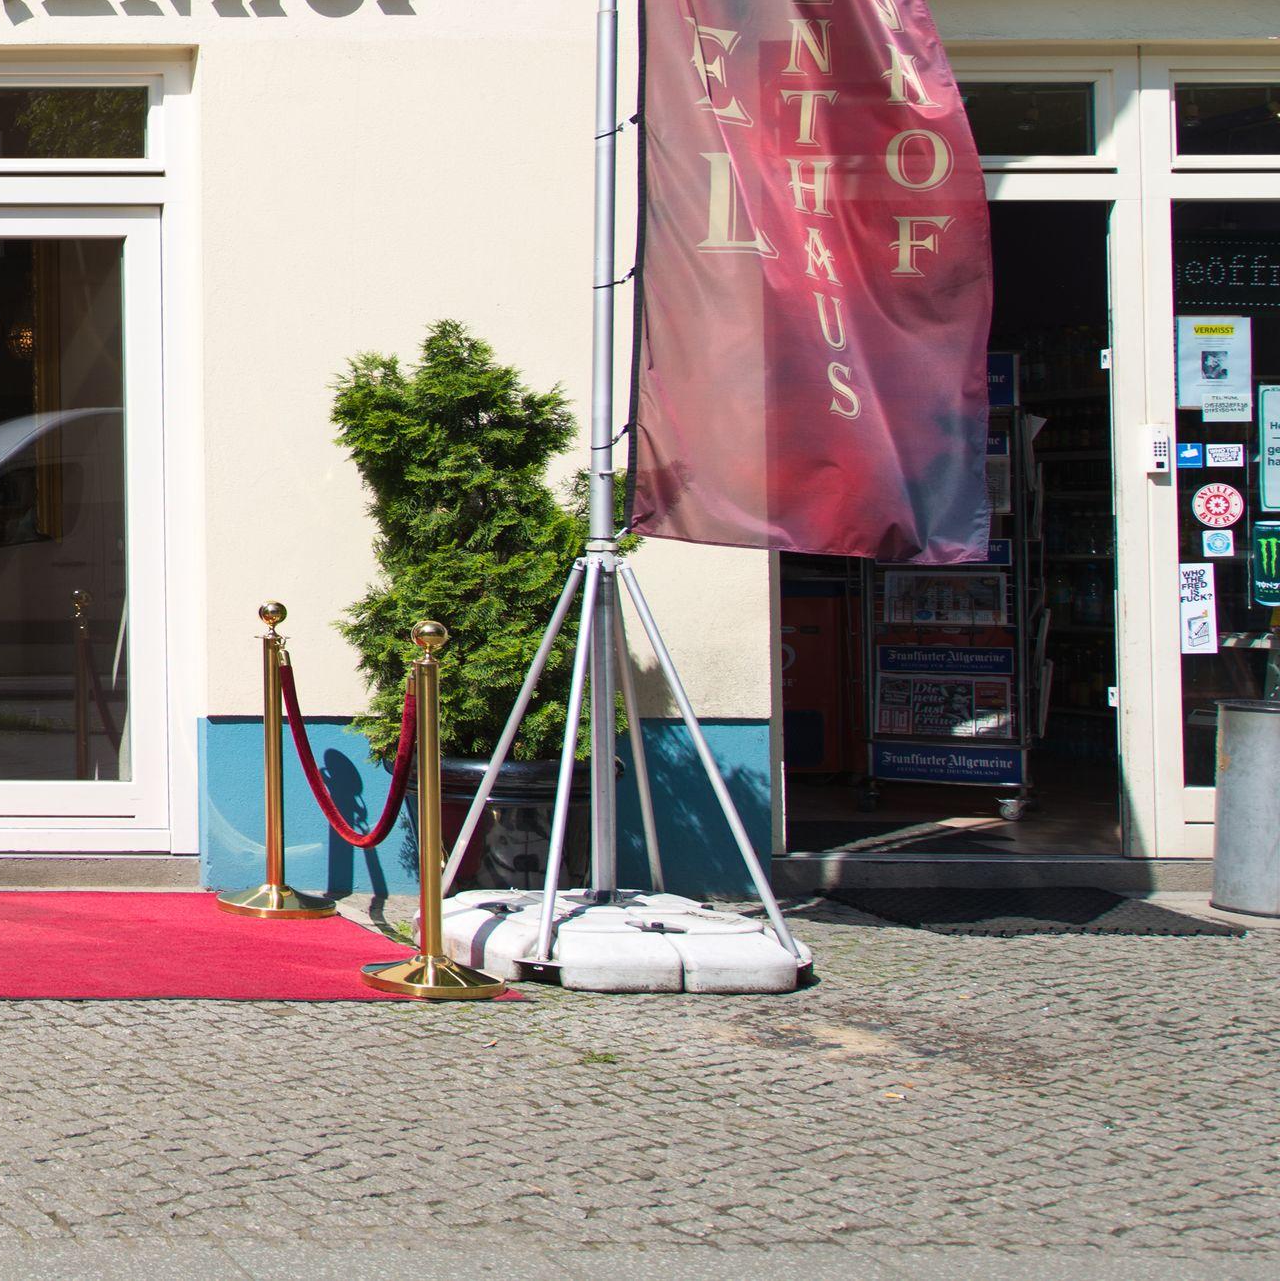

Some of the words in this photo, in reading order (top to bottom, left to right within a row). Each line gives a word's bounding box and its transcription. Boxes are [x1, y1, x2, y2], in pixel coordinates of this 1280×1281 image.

[1197, 486, 1235, 500] WULLE
[1198, 511, 1236, 525] BIERE
[1182, 569, 1205, 577] WHO
[1181, 581, 1207, 590] FRED
[1190, 587, 1199, 595] IS
[1180, 593, 1213, 603] FUCK?
[887, 650, 945, 662] Frankfurter
[946, 650, 1006, 664] Allgemeine
[914, 683, 940, 694] Die
[914, 703, 945, 713] Lust
[881, 709, 907, 727] Bild
[882, 751, 946, 766] Frankfurter
[947, 754, 1013, 769] Allgemeine
